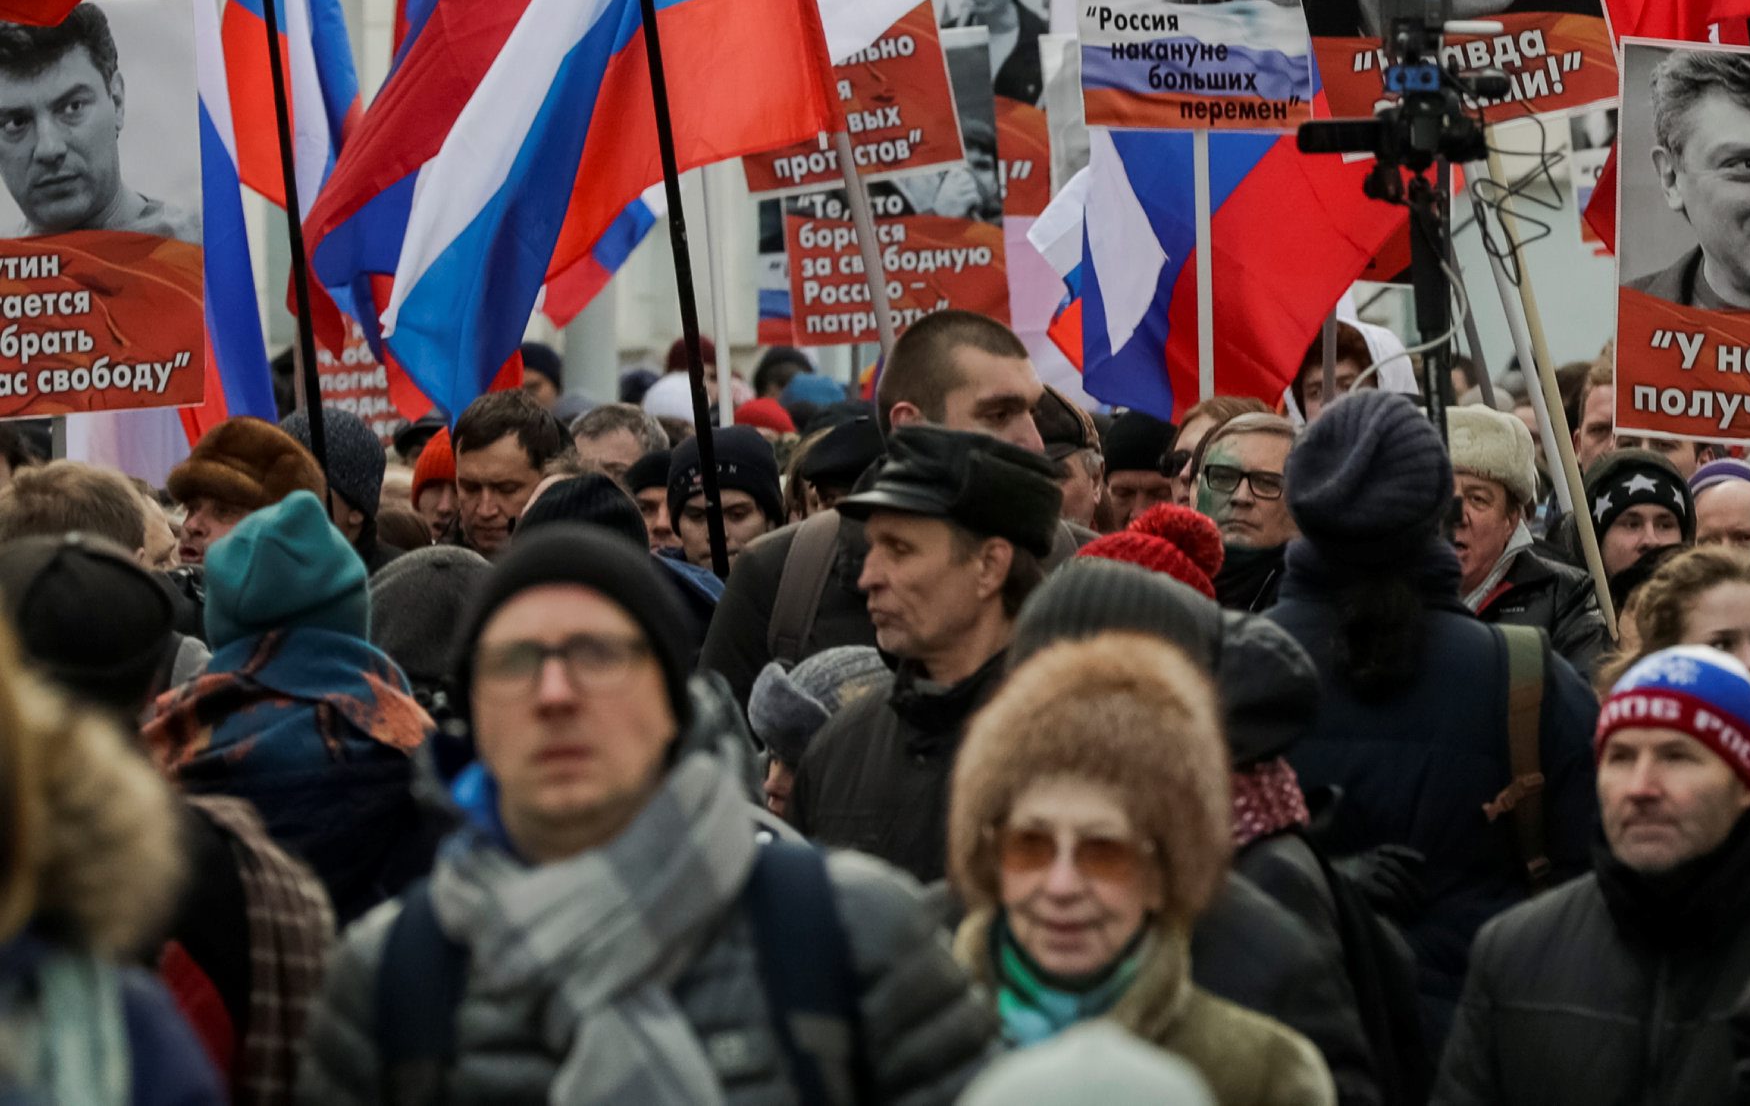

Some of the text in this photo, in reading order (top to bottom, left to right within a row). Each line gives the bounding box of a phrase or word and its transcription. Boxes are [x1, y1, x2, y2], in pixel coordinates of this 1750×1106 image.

[1085, 5, 1179, 31] “Россия
[1111, 42, 1228, 67] накануне
[1149, 64, 1257, 91] больших
[1180, 96, 1300, 125] перемен”
[773, 129, 923, 184] протстов”
[802, 256, 832, 278] за
[838, 245, 992, 273] свбодную
[0, 289, 90, 318] ается
[0, 327, 93, 364] брать
[1650, 329, 1705, 370] “У
[37, 352, 191, 394] свободу”
